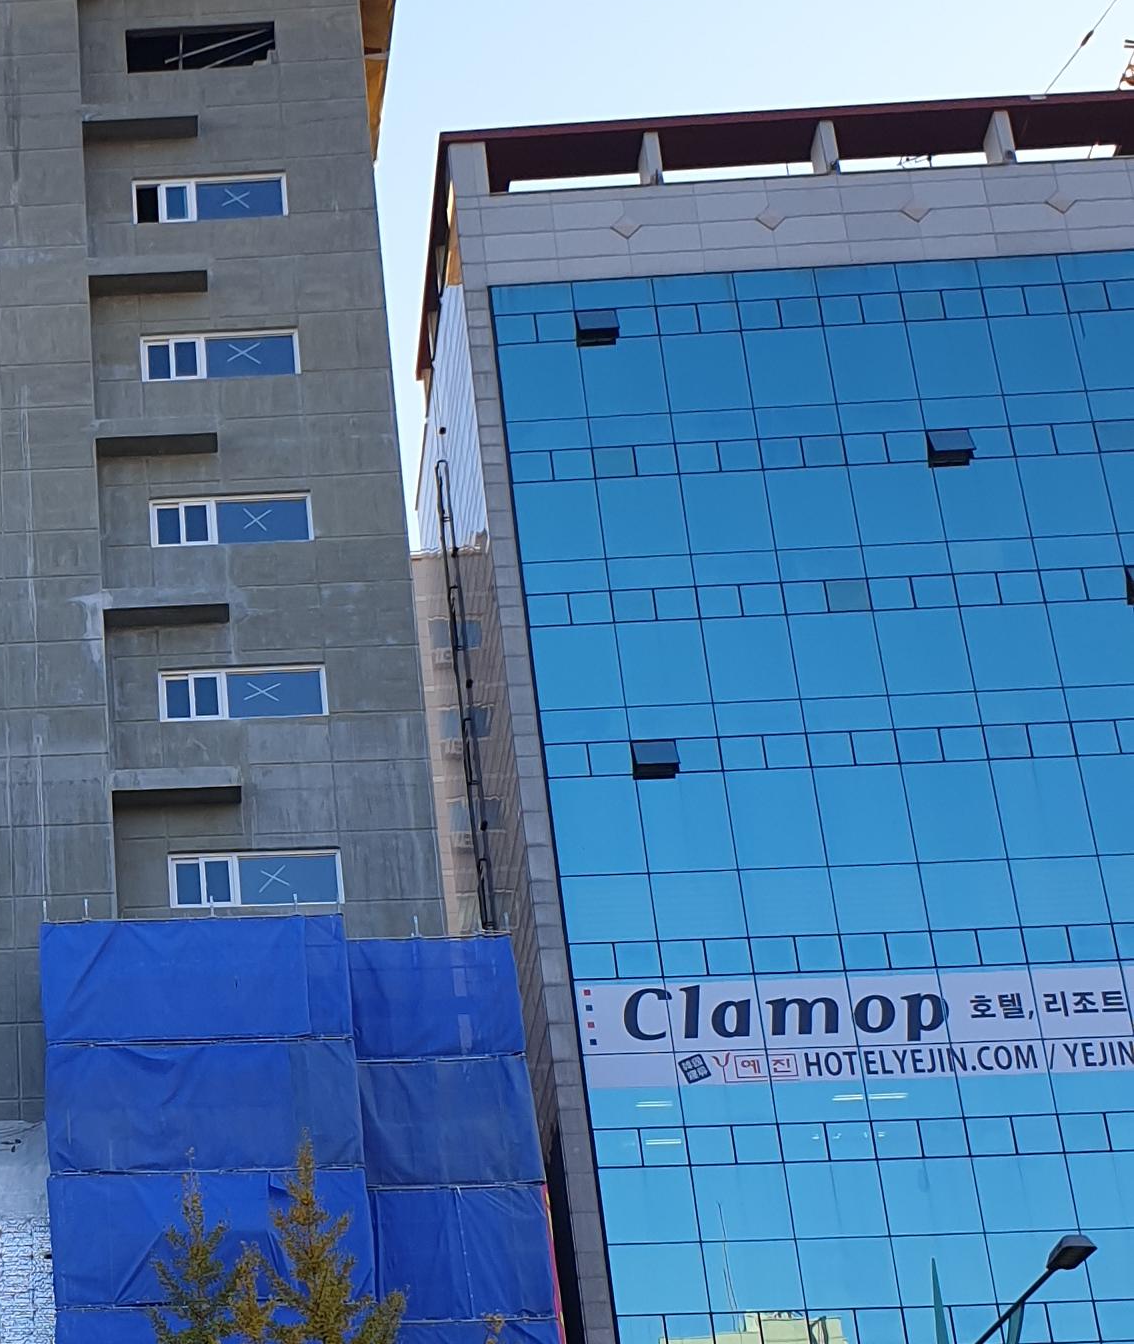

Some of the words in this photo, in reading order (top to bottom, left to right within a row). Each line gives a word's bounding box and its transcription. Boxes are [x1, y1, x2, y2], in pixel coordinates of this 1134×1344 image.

[623, 984, 949, 1042] Clamop
[1043, 990, 1128, 1017] 리조트
[804, 1043, 1039, 1078] HOTELYEJIN.COM
